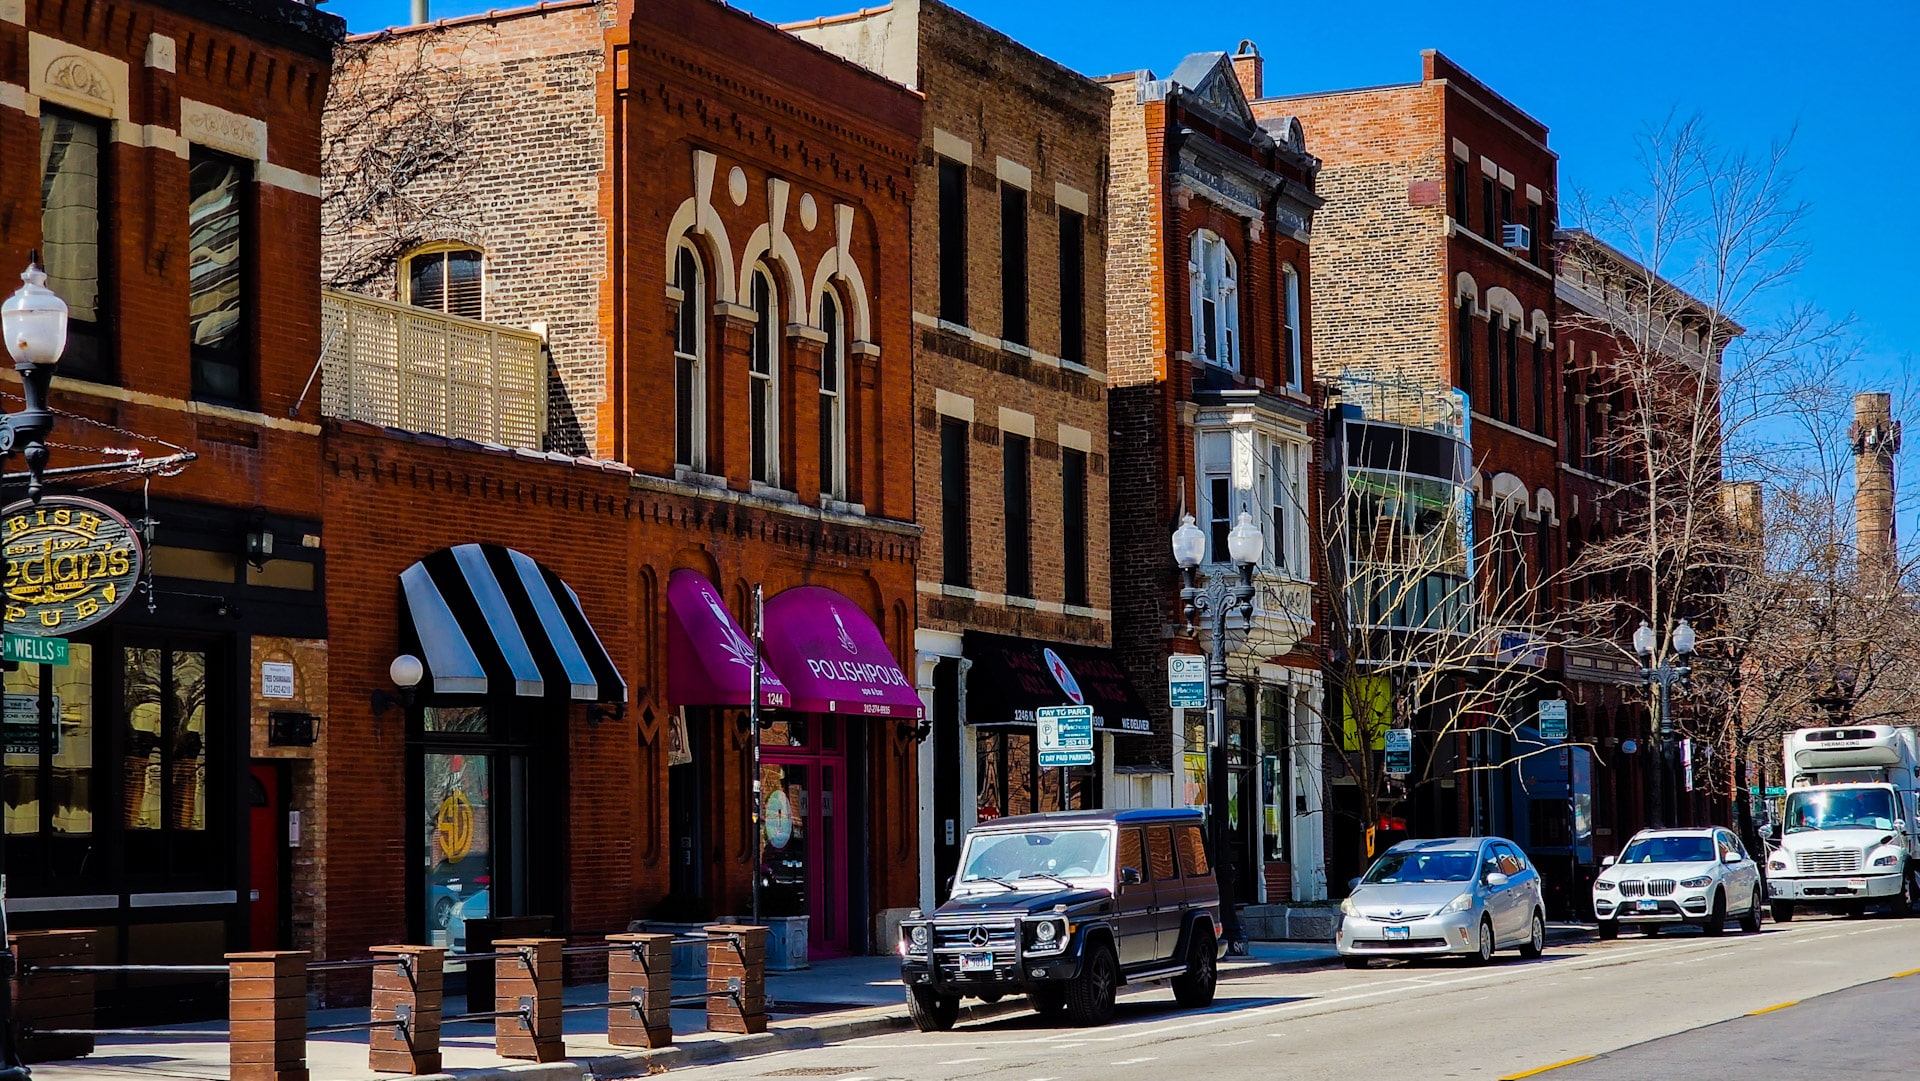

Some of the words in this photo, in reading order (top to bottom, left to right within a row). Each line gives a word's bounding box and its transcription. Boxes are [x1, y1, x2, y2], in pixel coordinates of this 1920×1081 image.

[6, 509, 102, 534] RISH
[55, 539, 90, 551] 1972
[4, 597, 100, 626] PUB
[6, 641, 12, 652] N
[14, 638, 55, 660] WELLS
[56, 646, 66, 657] ST
[767, 692, 783, 706] 1244
[1014, 709, 1029, 721] 1246
[1041, 709, 1056, 717] PAY
[1067, 708, 1087, 716] PARK
[1121, 717, 1131, 729] WE
[1130, 718, 1150, 731] DELIVER
[1068, 753, 1091, 761] PARKING
